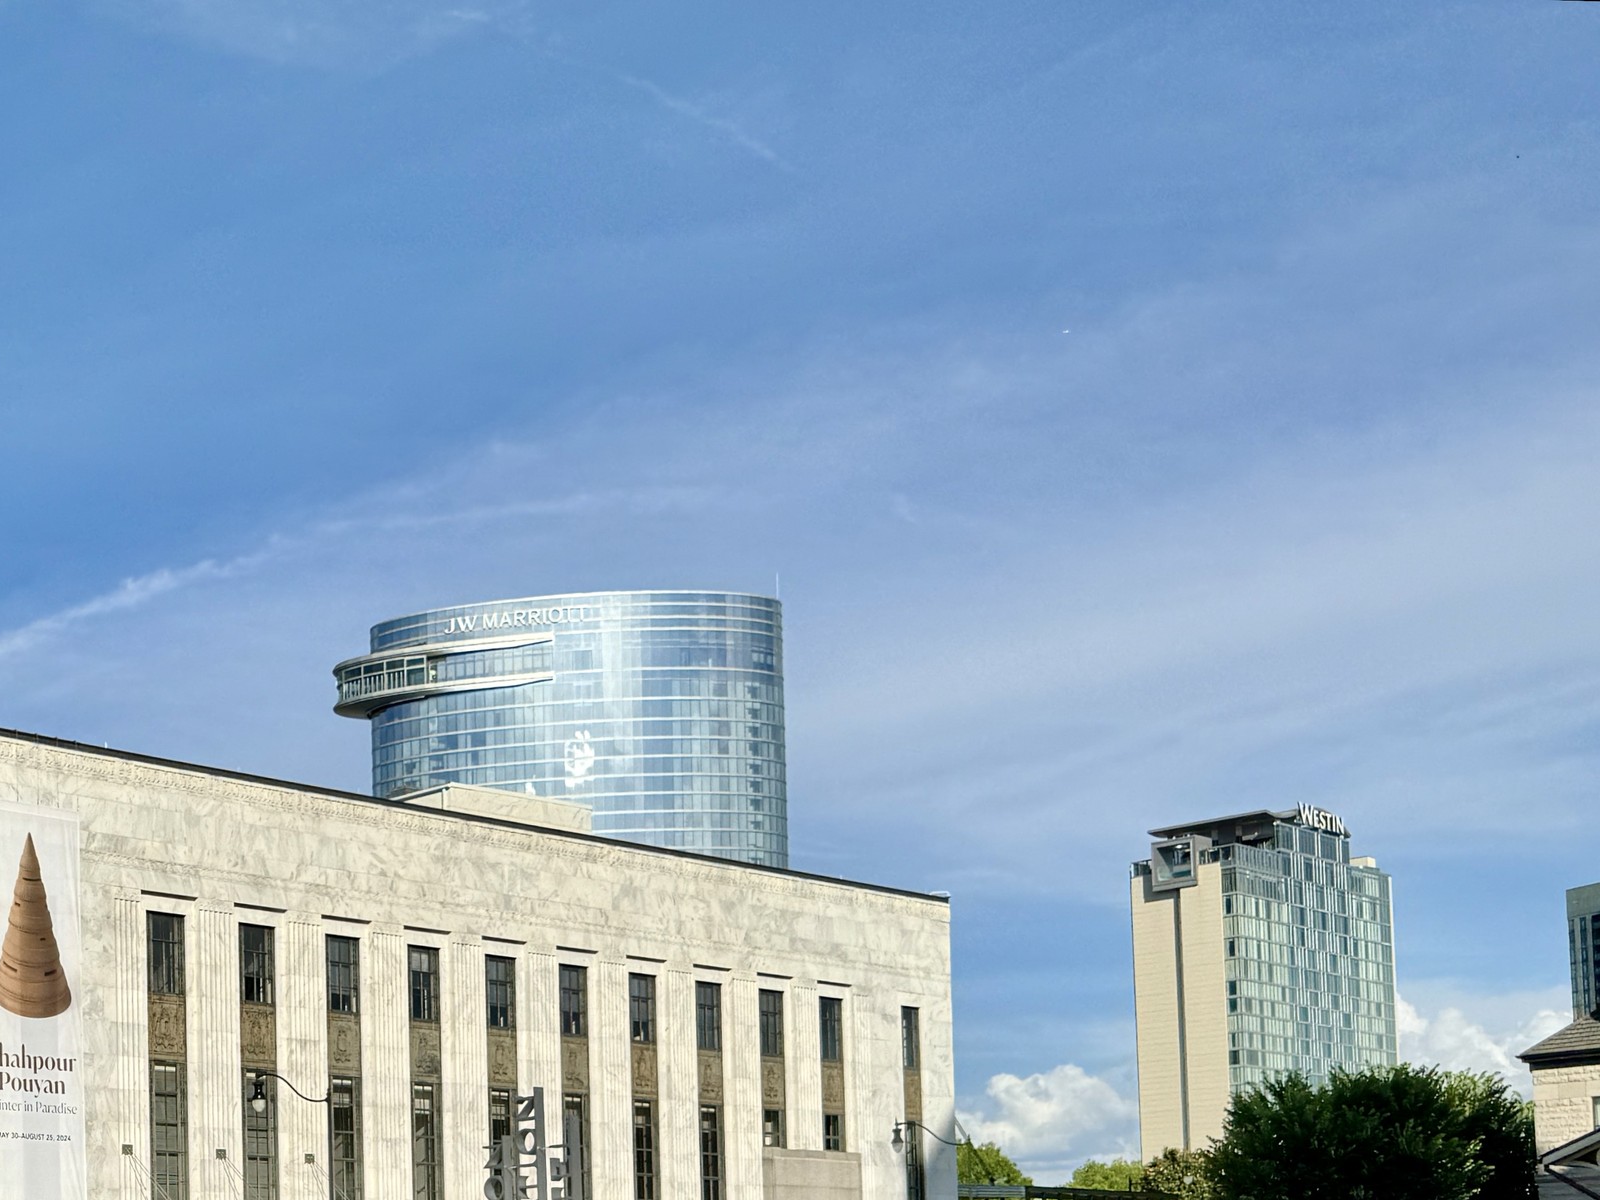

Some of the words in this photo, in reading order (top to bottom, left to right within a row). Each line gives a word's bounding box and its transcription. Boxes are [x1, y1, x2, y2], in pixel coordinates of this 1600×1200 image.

[444, 615, 478, 634] JW
[482, 607, 589, 631] MARRIOTT
[1297, 801, 1345, 835] WESTIN
[24, 1101, 33, 1112] in
[35, 1101, 78, 1115] Paradise
[56, 1134, 71, 1142] 2024
